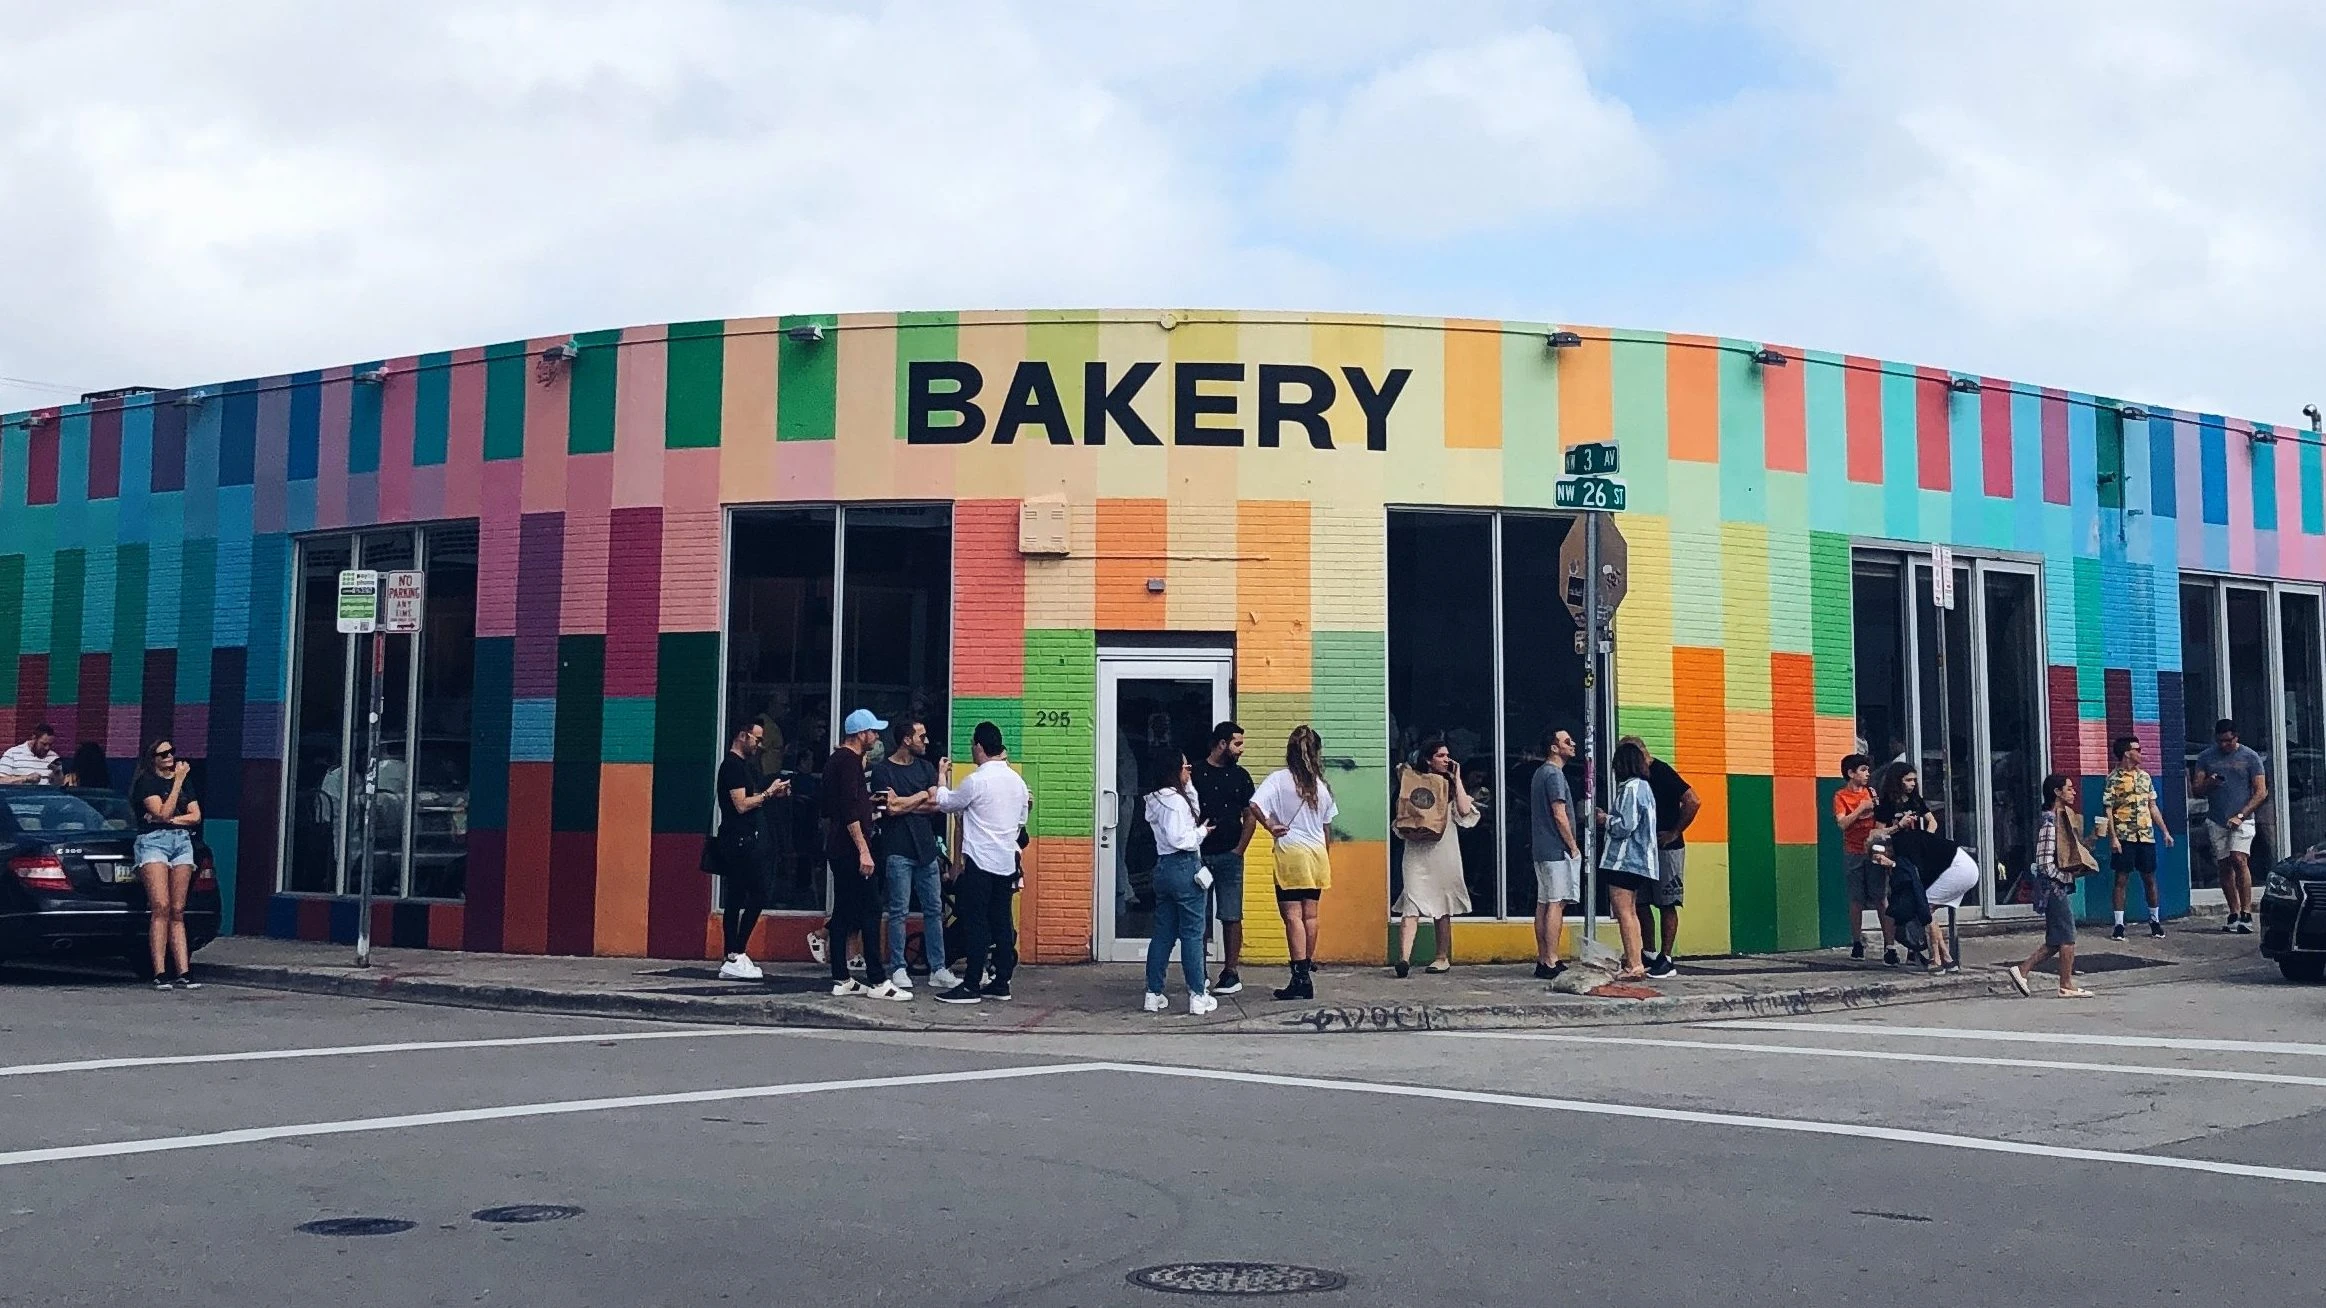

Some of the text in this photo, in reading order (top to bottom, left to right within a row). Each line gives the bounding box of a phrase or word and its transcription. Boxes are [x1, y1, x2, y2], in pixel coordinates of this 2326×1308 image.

[907, 361, 1413, 451] BAKERY
[1583, 448, 1593, 471] 3
[1603, 449, 1616, 466] AV
[1557, 481, 1624, 506] NW 26 ST
[399, 575, 412, 587] NO
[389, 587, 420, 599] PARKING
[397, 600, 412, 608] ANY
[1034, 710, 1071, 727] 295
